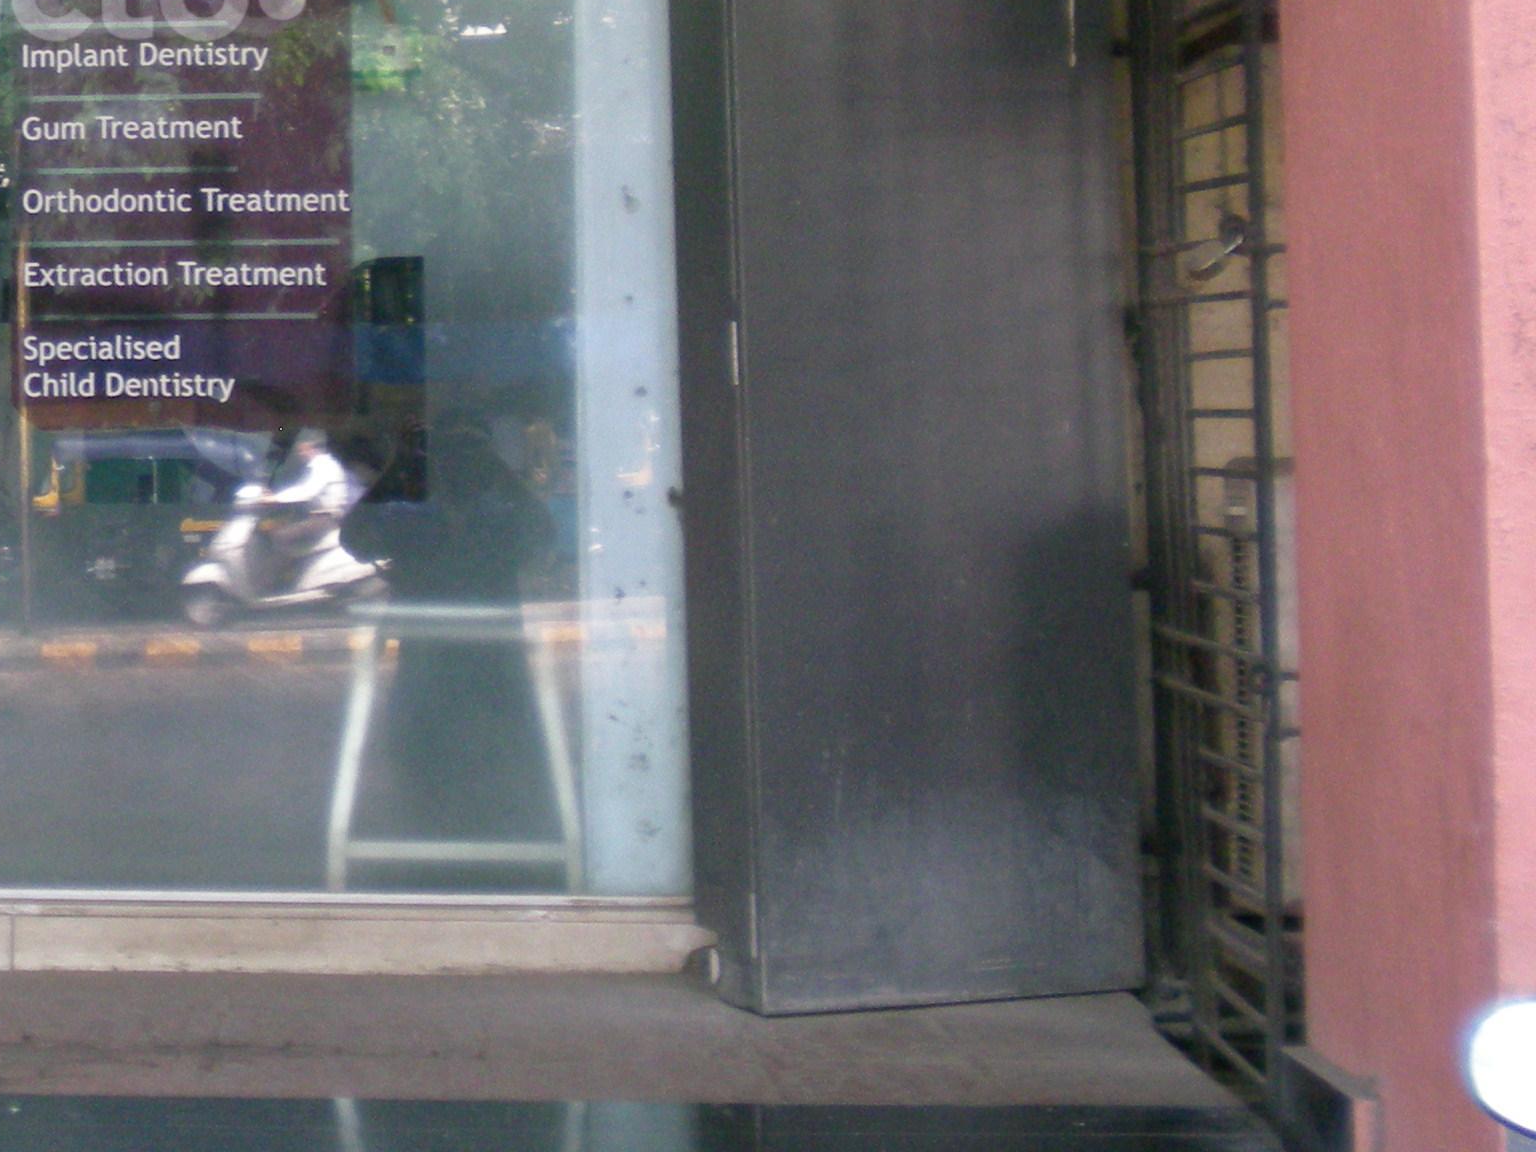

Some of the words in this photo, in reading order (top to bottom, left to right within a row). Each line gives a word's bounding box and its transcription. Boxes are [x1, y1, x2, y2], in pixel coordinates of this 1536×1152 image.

[22, 43, 129, 73] Implant
[140, 42, 268, 71] Dentistry
[22, 117, 86, 141] Gum
[96, 115, 243, 140] Treatment
[22, 188, 192, 214] Orthodontic
[201, 187, 350, 212] Treatment
[24, 262, 168, 287] Extraction
[176, 261, 327, 286] Treatment
[24, 334, 181, 366] Specialised
[24, 373, 95, 398] Child
[105, 372, 235, 402] Dentistry
